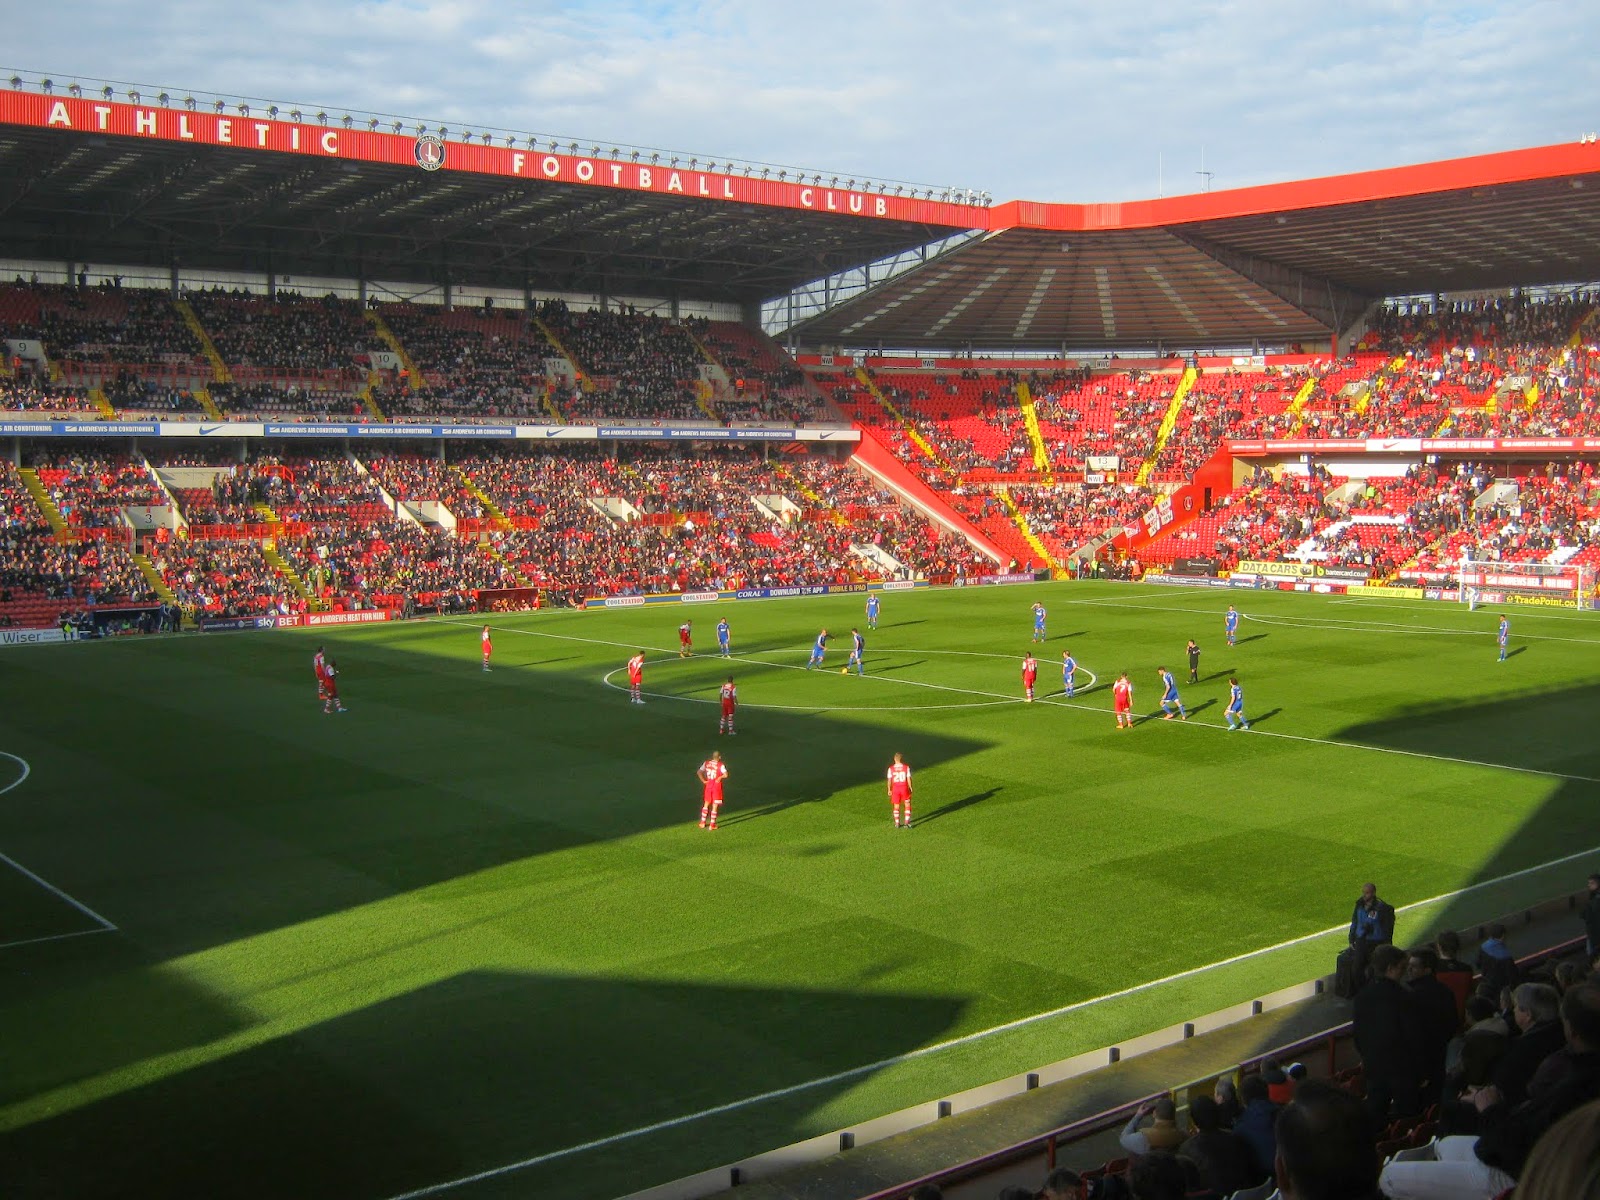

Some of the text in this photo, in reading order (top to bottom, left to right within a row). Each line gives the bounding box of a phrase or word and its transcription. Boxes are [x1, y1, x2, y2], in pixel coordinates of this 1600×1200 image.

[48, 101, 887, 217] ATHLETIC FOOTBALL CLUB
[18, 342, 27, 352] 9
[378, 354, 390, 363] 10
[1513, 377, 1526, 386] 20
[1098, 457, 1108, 465] 13
[145, 513, 152, 524] 3
[1242, 563, 1298, 575] DATA CARS
[966, 577, 979, 585] BET
[683, 593, 717, 601] TOOLSTATION
[738, 590, 761, 598] CORAL
[770, 588, 800, 597] DOWNLOAD
[812, 586, 824, 594] APP
[1426, 590, 1460, 600] sky BET
[607, 598, 644, 606] TOOLSTATION
[1482, 593, 1501, 603] BET
[258, 617, 275, 628] sky
[279, 616, 300, 626] BET
[321, 611, 386, 623] ANDREWS HEAT FOR HIRE
[2, 632, 41, 643] Wiser
[893, 771, 906, 783] 20
